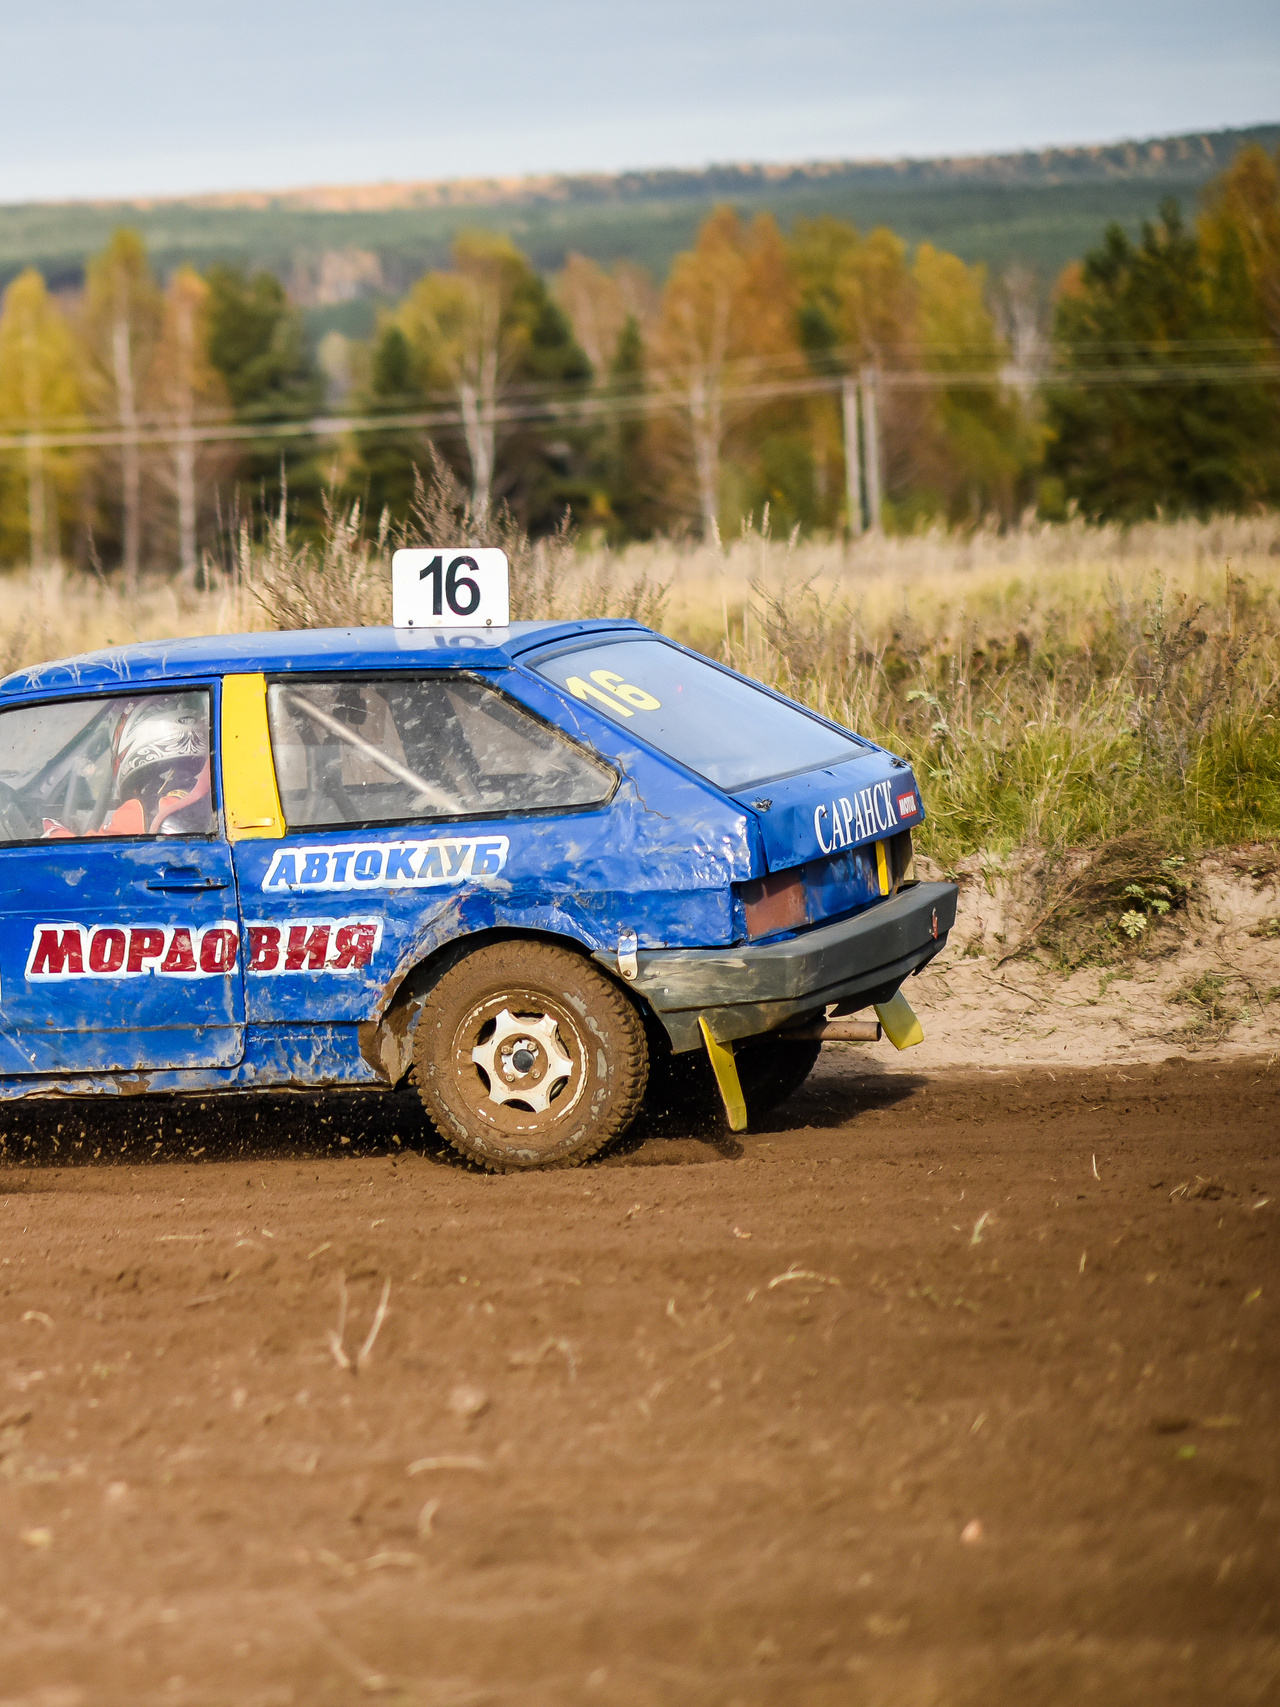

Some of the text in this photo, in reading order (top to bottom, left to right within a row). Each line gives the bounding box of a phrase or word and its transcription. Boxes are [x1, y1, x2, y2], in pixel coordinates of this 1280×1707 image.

[419, 555, 481, 616] 16
[565, 669, 661, 717] 16
[814, 779, 898, 854] САРАНСК
[268, 841, 504, 888] АВТОКЛУБ
[29, 921, 378, 975] МОРДОВИЯ
